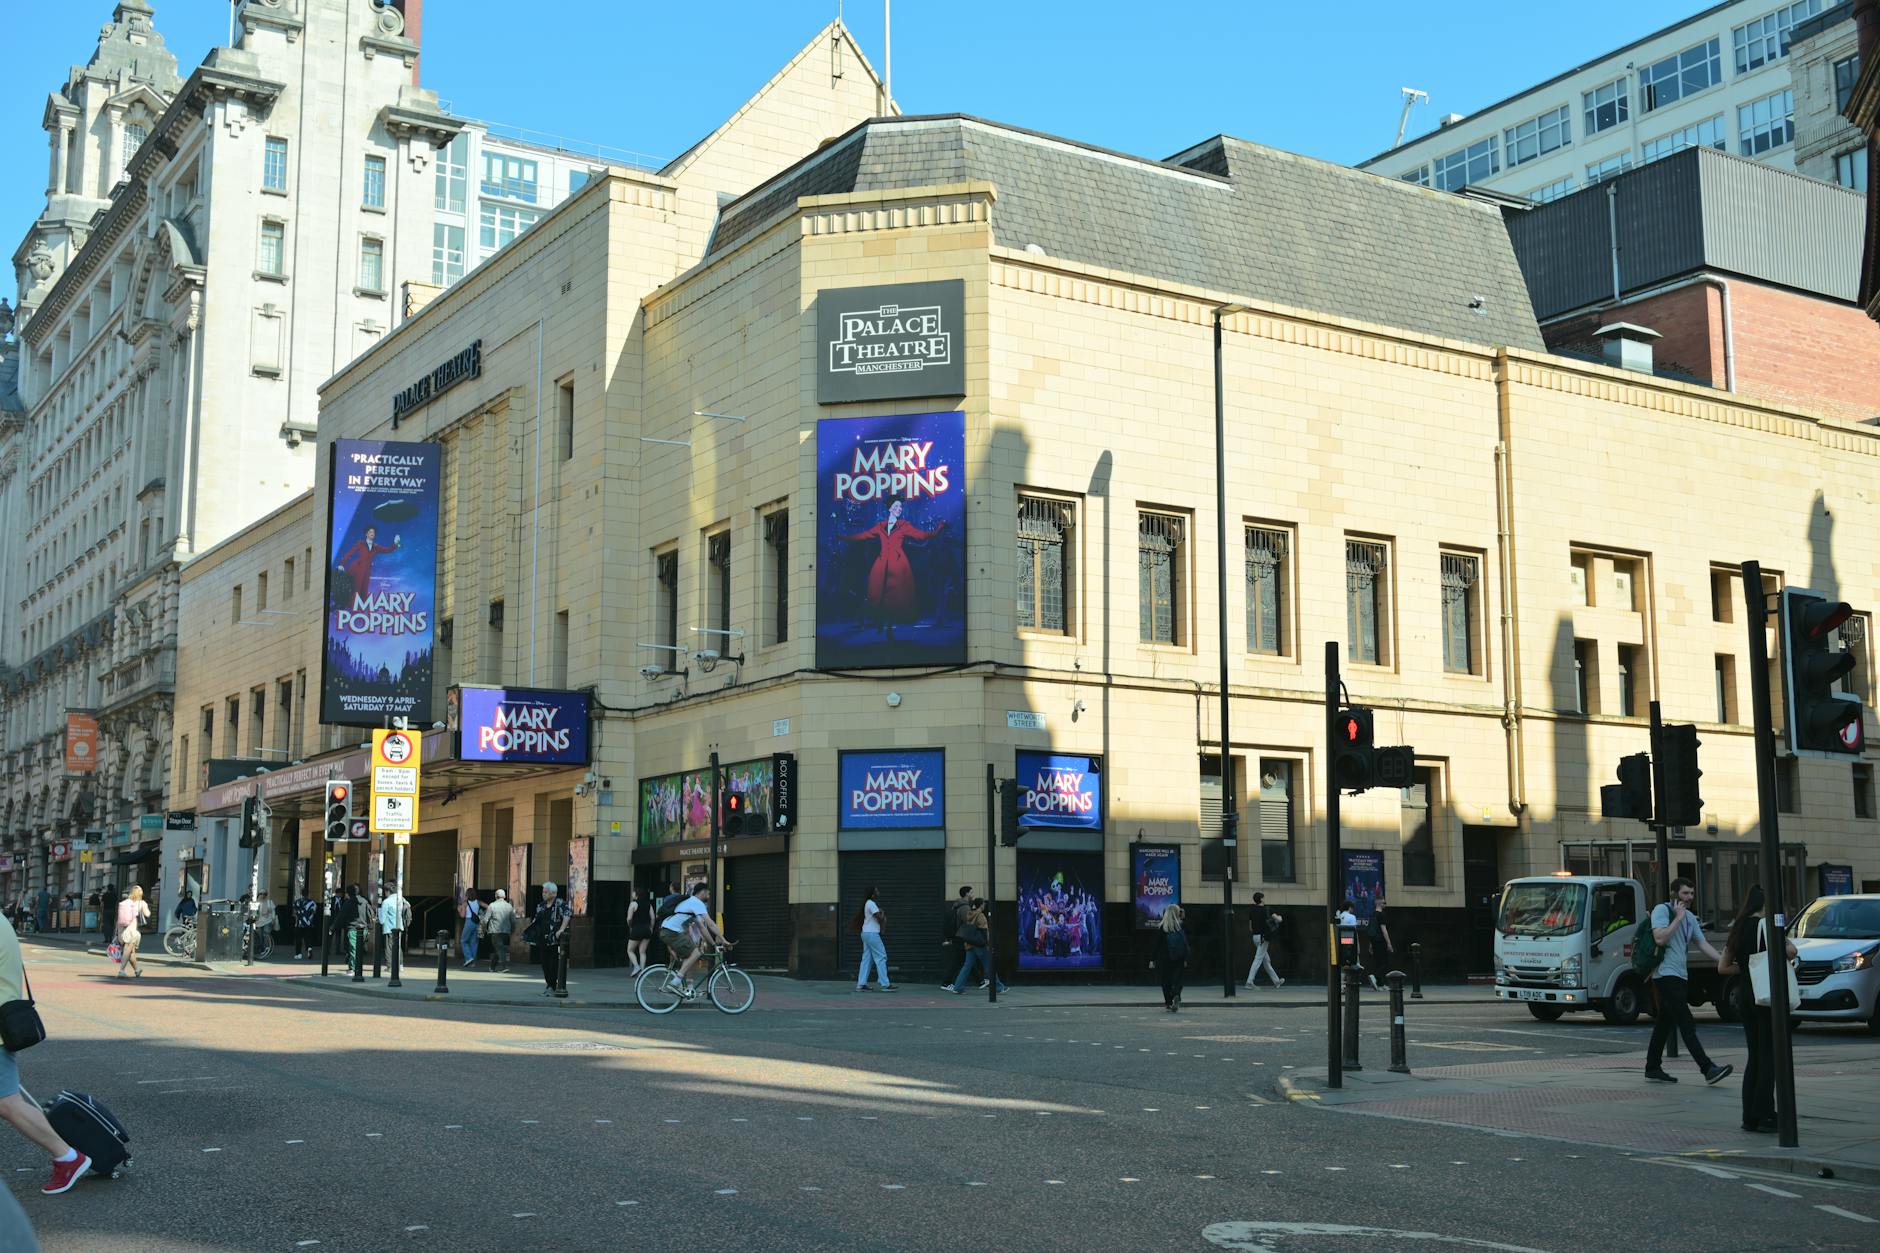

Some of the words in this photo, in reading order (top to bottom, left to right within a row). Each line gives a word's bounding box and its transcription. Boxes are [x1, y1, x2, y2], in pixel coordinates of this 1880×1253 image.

[844, 315, 938, 341] PALACE
[836, 338, 946, 364] THEATRE
[857, 361, 921, 373] MANCHESTER
[392, 374, 431, 429] PALACE
[431, 339, 482, 393] THEATRE
[854, 442, 933, 473] MARY
[348, 475, 361, 485] IN
[364, 476, 398, 487] EVERY
[365, 465, 410, 476] PERFECT
[836, 466, 949, 501] POPPINS
[353, 591, 416, 613] MARY
[337, 609, 427, 635] POPPINS
[339, 695, 387, 704] WEDNESDAY
[388, 696, 393, 704] 9
[344, 703, 384, 711] SATURDAY
[394, 704, 413, 712] MAY
[495, 705, 558, 730] MARY
[1008, 711, 1044, 721] WHITWORTH
[479, 725, 570, 753] POPPINS
[293, 768, 312, 782] PERFECT
[780, 759, 788, 778] BOX
[865, 769, 922, 791] MARY
[1037, 771, 1083, 793] MARY
[780, 780, 788, 809] OFFICE
[852, 787, 934, 811] POPPINS
[1026, 790, 1092, 813] POPPINS
[169, 817, 181, 826] Stage
[182, 817, 192, 825] Door
[1143, 885, 1173, 896] POPPINS
[1148, 877, 1168, 887] MARY
